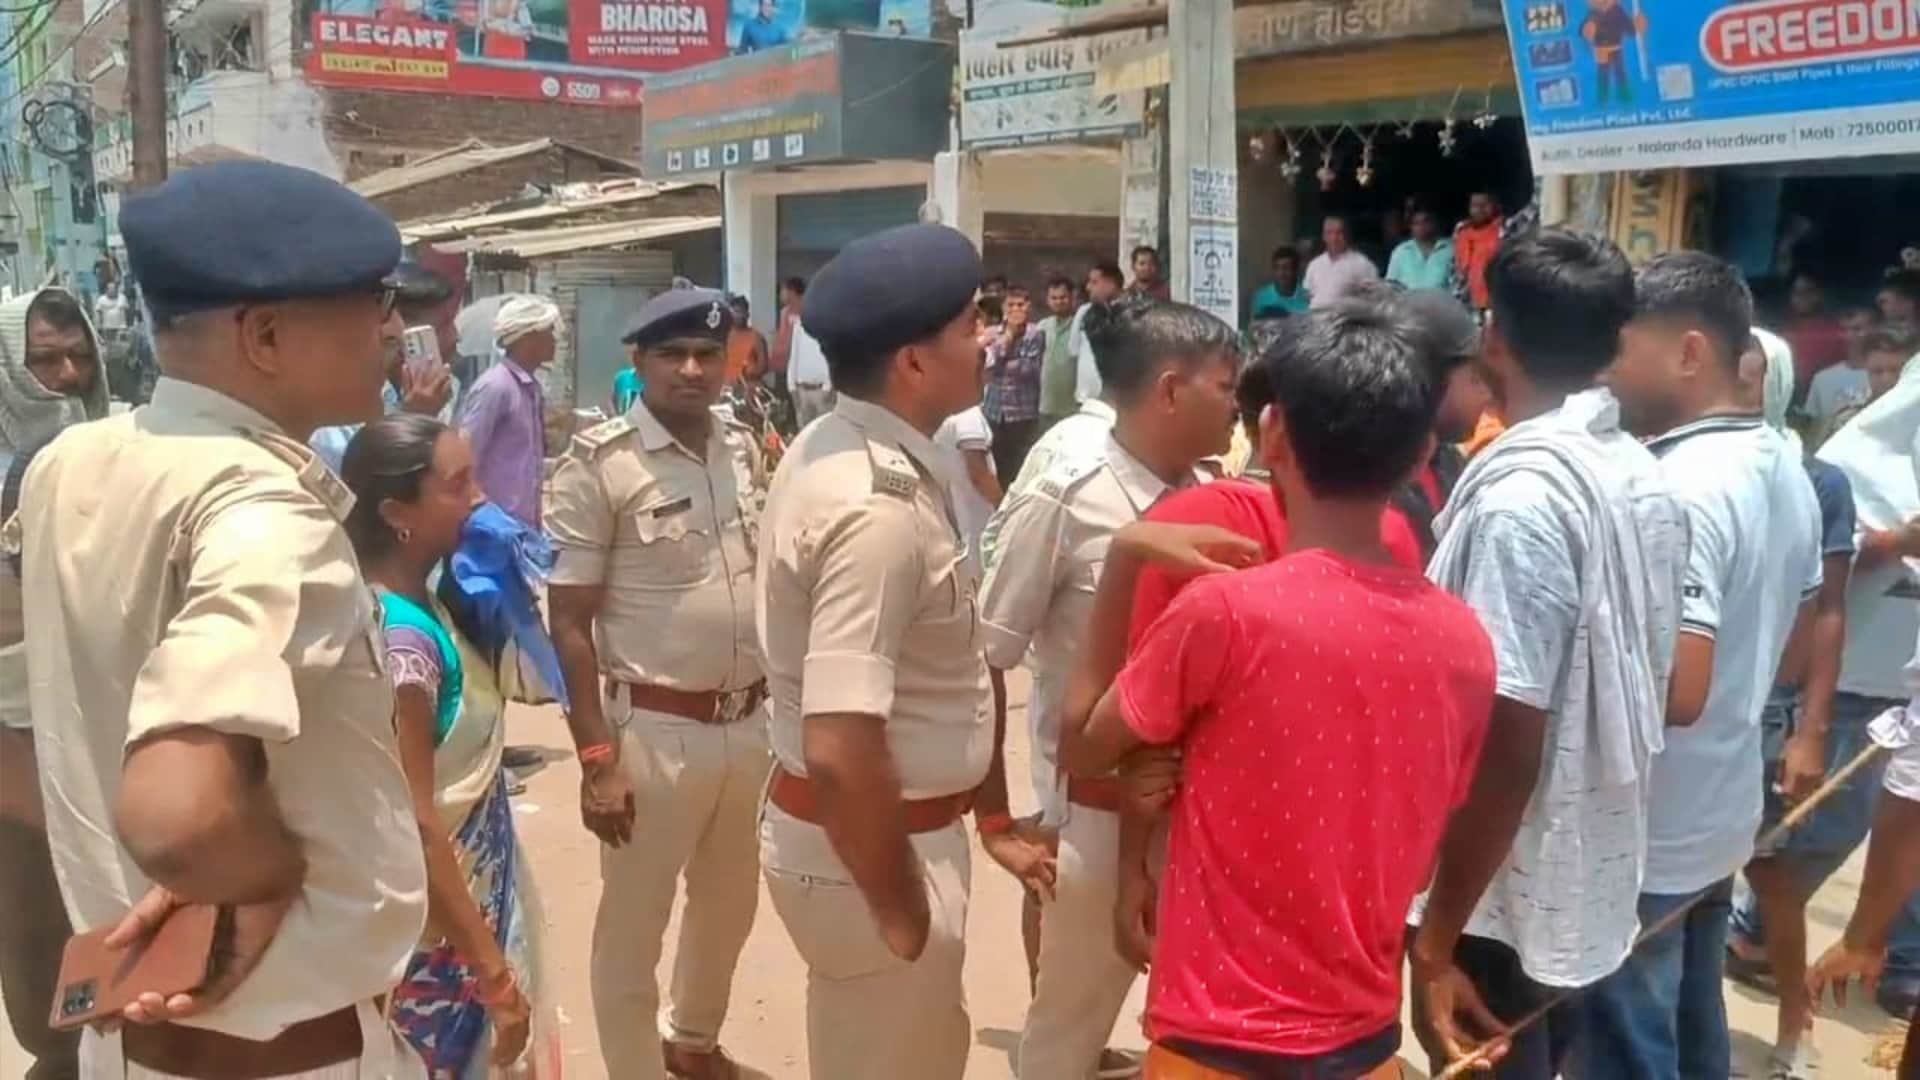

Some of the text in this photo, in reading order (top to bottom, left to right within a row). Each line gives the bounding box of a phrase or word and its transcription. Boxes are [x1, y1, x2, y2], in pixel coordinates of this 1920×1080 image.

[600, 4, 708, 32] BHAROSA
[319, 20, 449, 50] ELEGANT
[1705, 132, 1787, 150] Hardware
